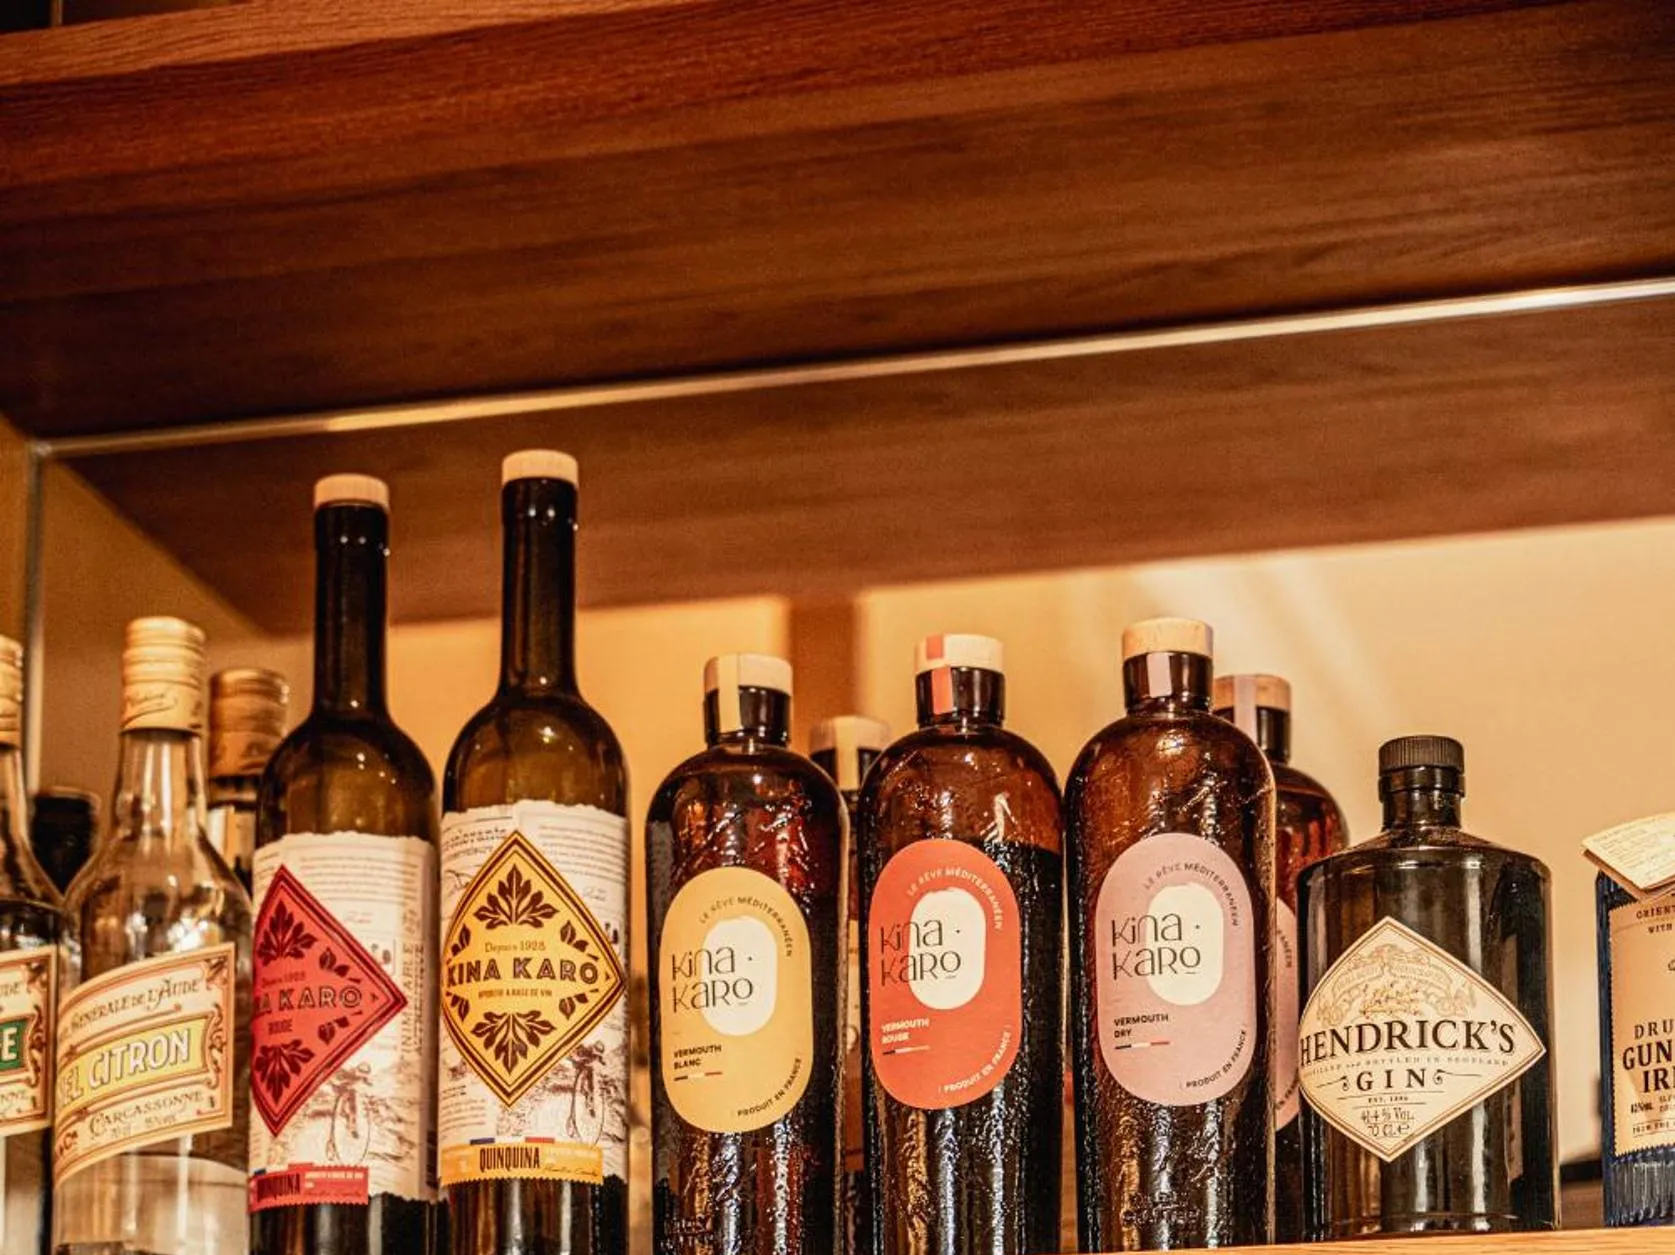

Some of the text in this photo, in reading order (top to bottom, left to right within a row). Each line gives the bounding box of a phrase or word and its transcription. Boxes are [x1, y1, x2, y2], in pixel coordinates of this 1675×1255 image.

[1636, 904, 1675, 920] ORIEN
[1648, 923, 1673, 934] WITH
[447, 956, 599, 988] KINA KARO
[278, 984, 362, 1012] KARO
[880, 1017, 930, 1033] VERMOUTH
[1113, 1012, 1169, 1027] VERMOUTH
[1633, 1018, 1674, 1040] DRU
[1113, 1028, 1132, 1039] DRY
[1299, 1018, 1516, 1068] HENDRICK'S
[87, 1027, 191, 1090] CITRON
[673, 1044, 722, 1059] VERMOUTH
[673, 1057, 702, 1070] BLANC
[1186, 1028, 1247, 1089] PRODUIT EN FRANCE
[1622, 1038, 1673, 1071] GUN
[737, 1057, 801, 1117] PRODUIT EN FRANCE
[1356, 1067, 1426, 1092] GIN
[1642, 1065, 1675, 1094] IR
[479, 1146, 541, 1174] QUINQUINA
